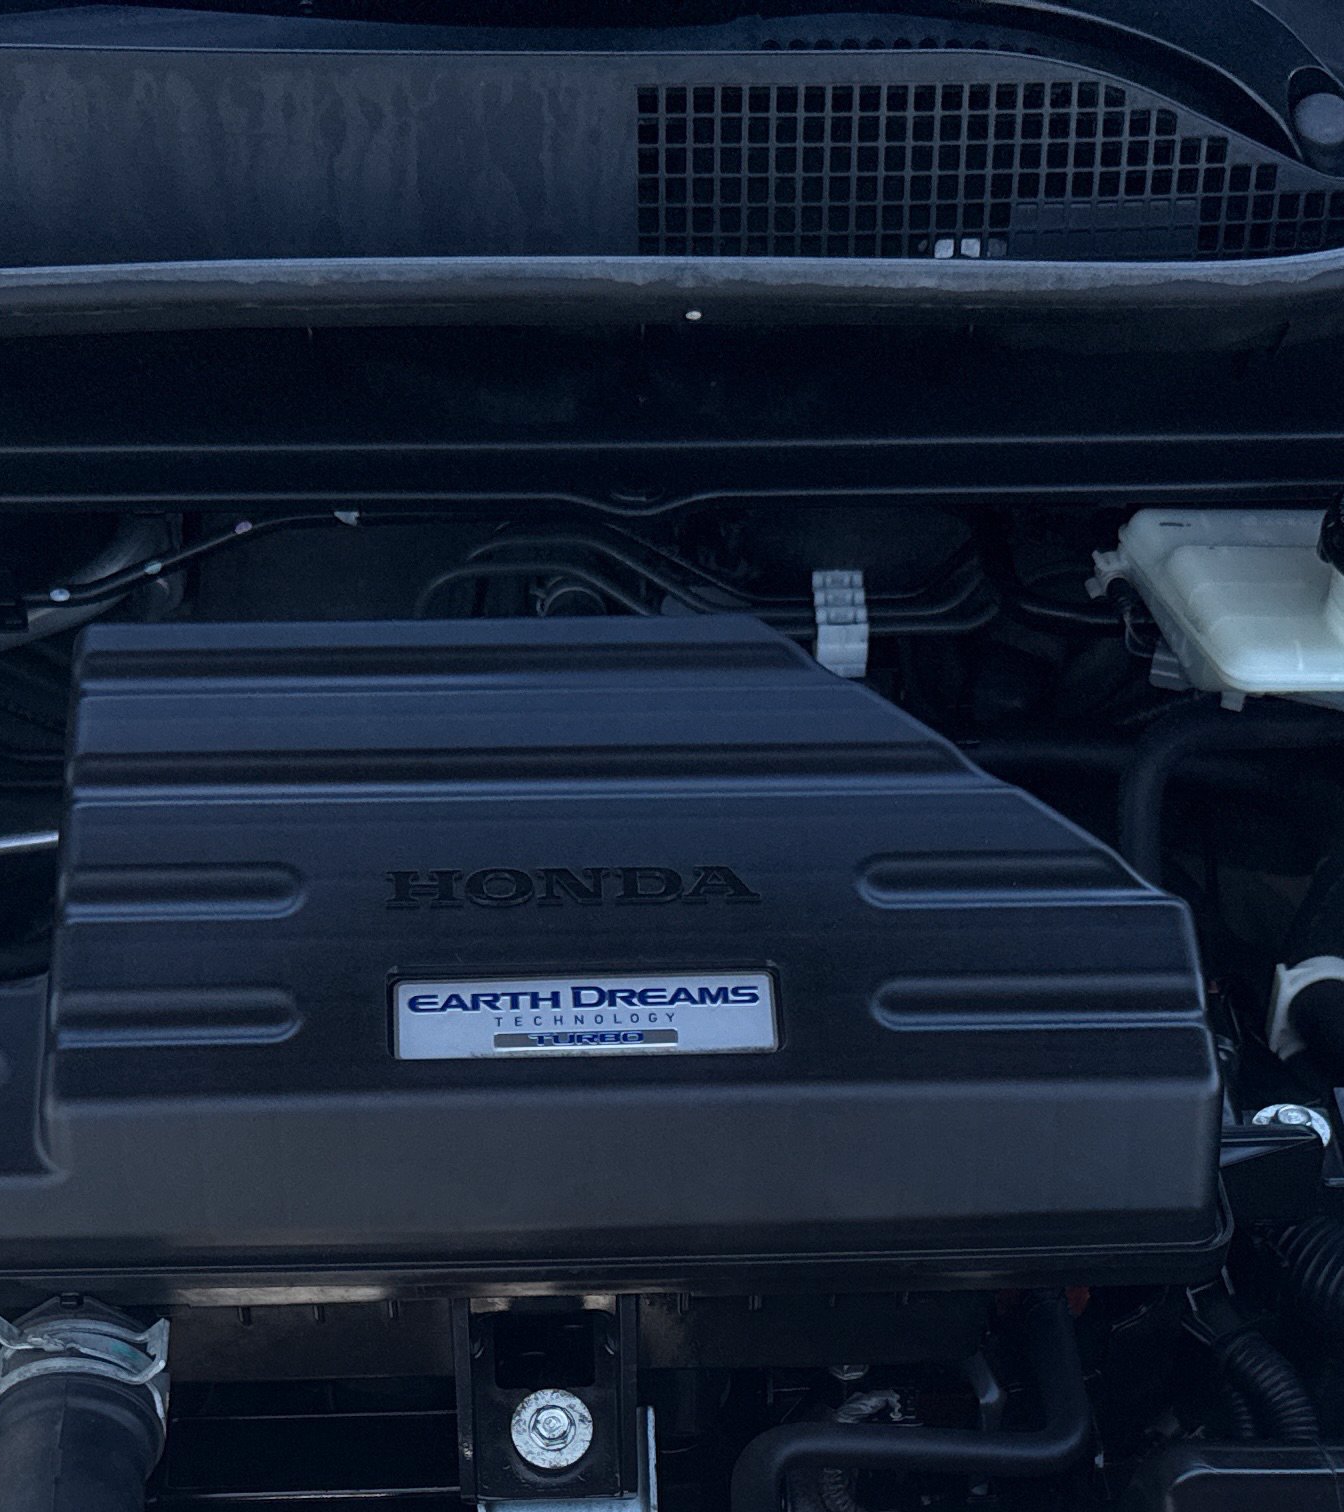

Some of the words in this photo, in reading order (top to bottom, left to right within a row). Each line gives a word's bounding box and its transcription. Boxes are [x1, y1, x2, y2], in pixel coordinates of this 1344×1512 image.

[386, 865, 761, 909] HONDA
[408, 989, 560, 1013] EARTH
[571, 985, 759, 1009] DREAMS
[494, 1011, 676, 1027] TECHNOLOGY
[528, 1029, 645, 1046] TURBO
